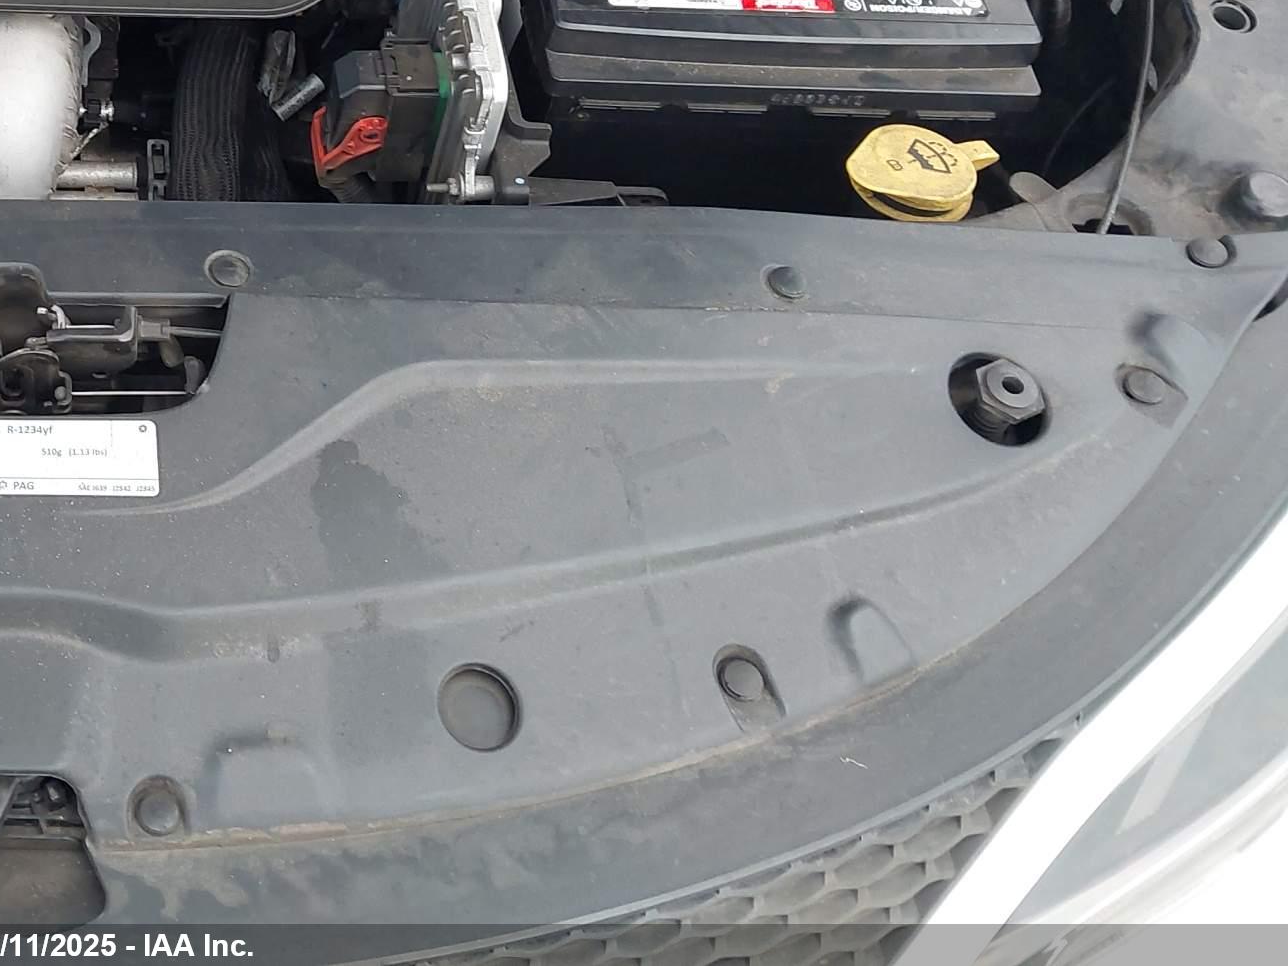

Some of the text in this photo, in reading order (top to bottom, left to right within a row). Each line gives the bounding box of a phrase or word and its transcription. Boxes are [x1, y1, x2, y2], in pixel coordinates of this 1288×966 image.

[7, 424, 54, 436] R-1234yf
[41, 448, 62, 457] 510g
[13, 481, 35, 491] PAG
